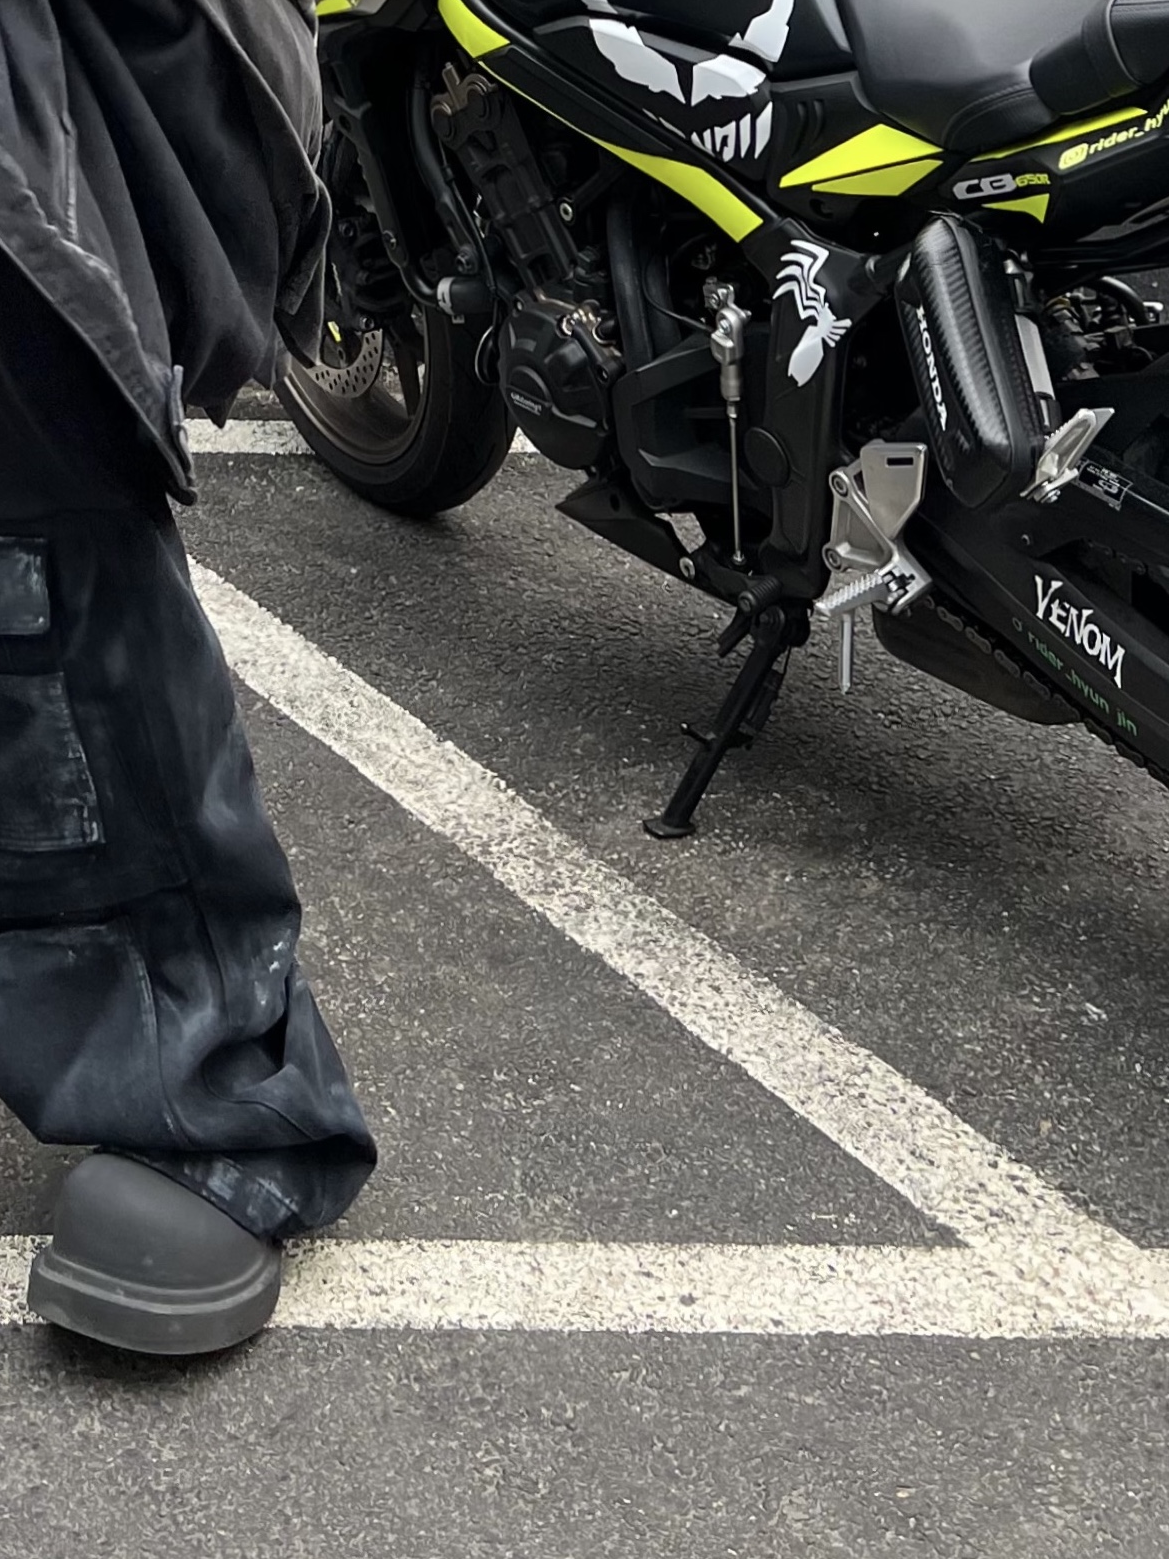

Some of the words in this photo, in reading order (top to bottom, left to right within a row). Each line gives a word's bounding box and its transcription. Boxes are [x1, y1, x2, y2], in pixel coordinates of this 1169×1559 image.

[952, 173, 1017, 200] CB
[1014, 173, 1051, 187] 650R
[915, 304, 948, 432] HONDA
[1034, 574, 1126, 689] VENOM
